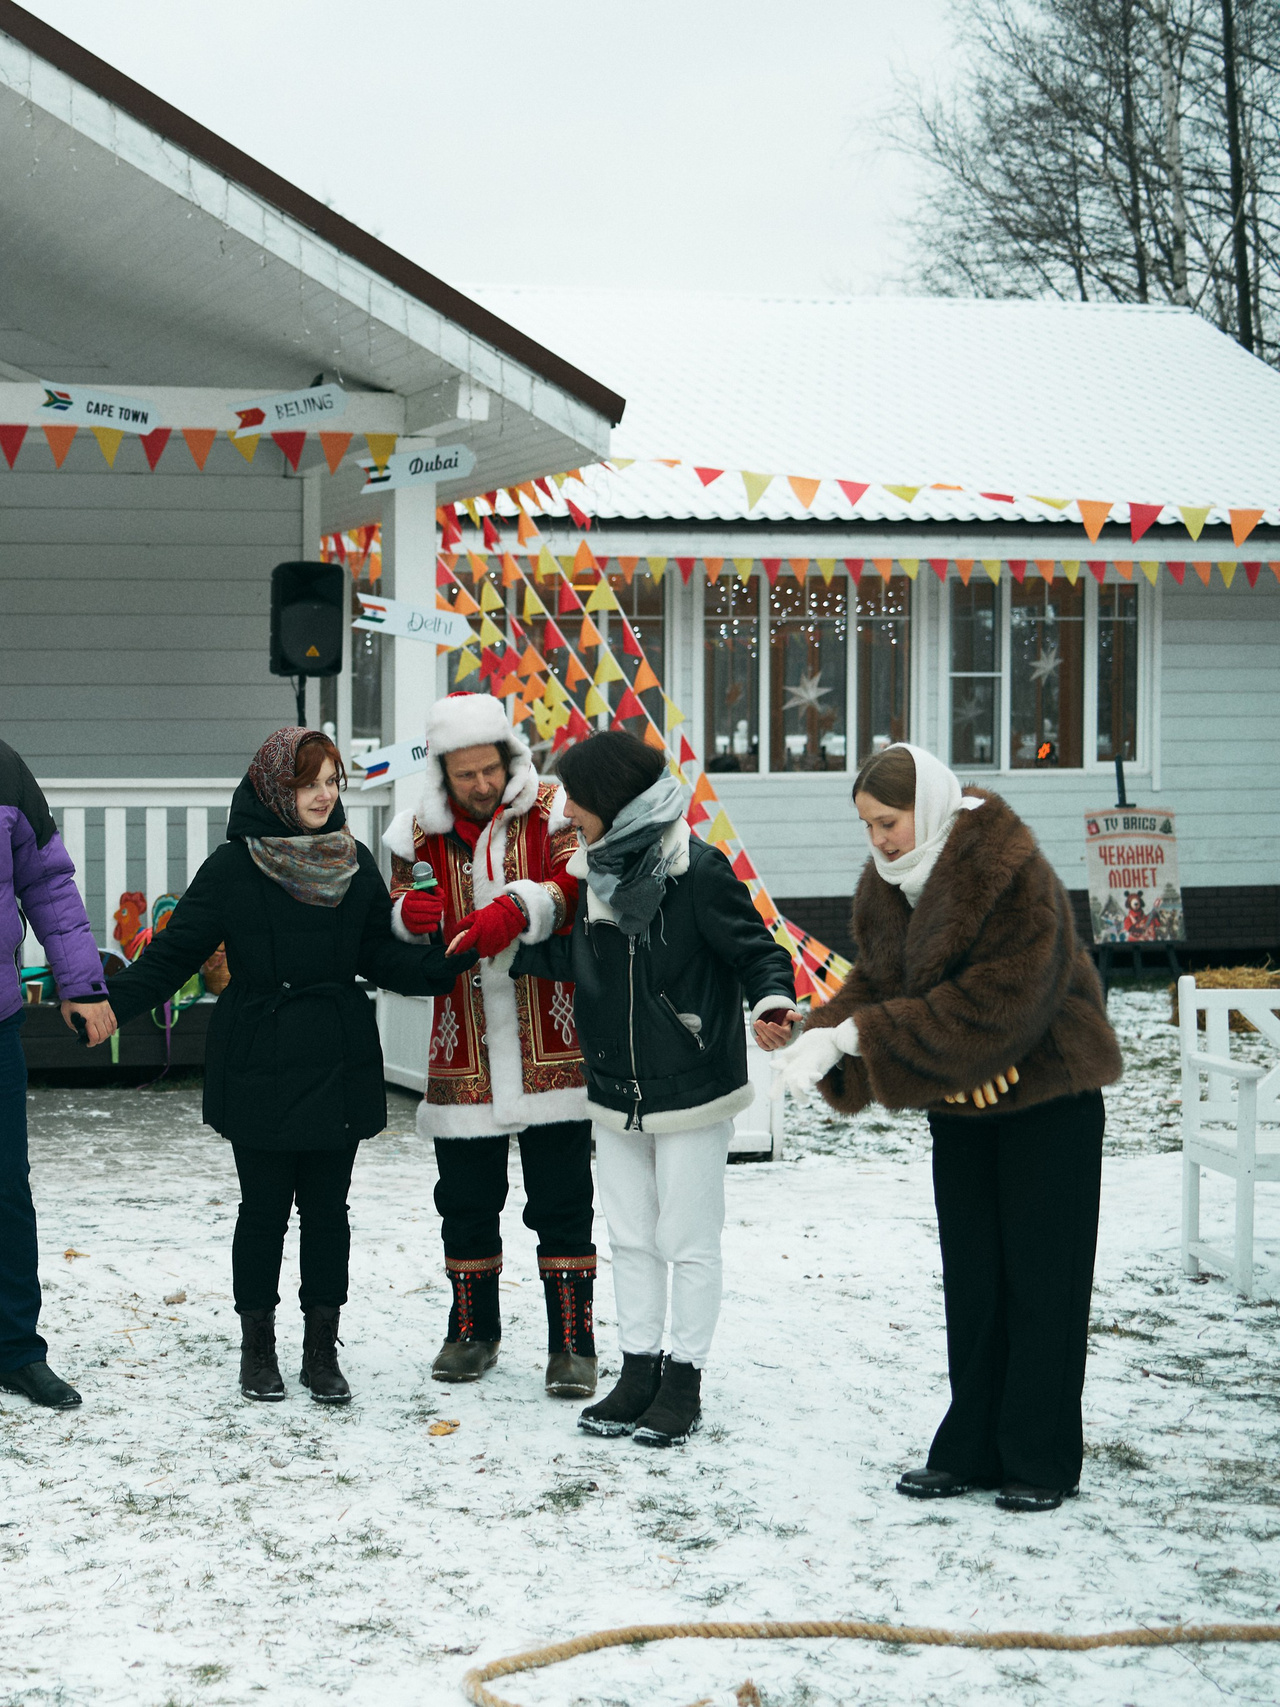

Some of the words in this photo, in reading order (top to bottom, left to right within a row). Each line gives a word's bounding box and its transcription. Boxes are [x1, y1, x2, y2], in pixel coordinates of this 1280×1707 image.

[86, 401, 115, 418] CAPE
[118, 407, 149, 424] TOWN
[275, 393, 334, 420] BEIJING
[408, 451, 459, 476] Dubai
[407, 611, 453, 636] Delhi
[1103, 817, 1118, 832] TV
[1122, 816, 1157, 831] BRICS
[1098, 844, 1165, 866] ЧЕКАНКА
[1108, 867, 1157, 889] МОНЕТ
